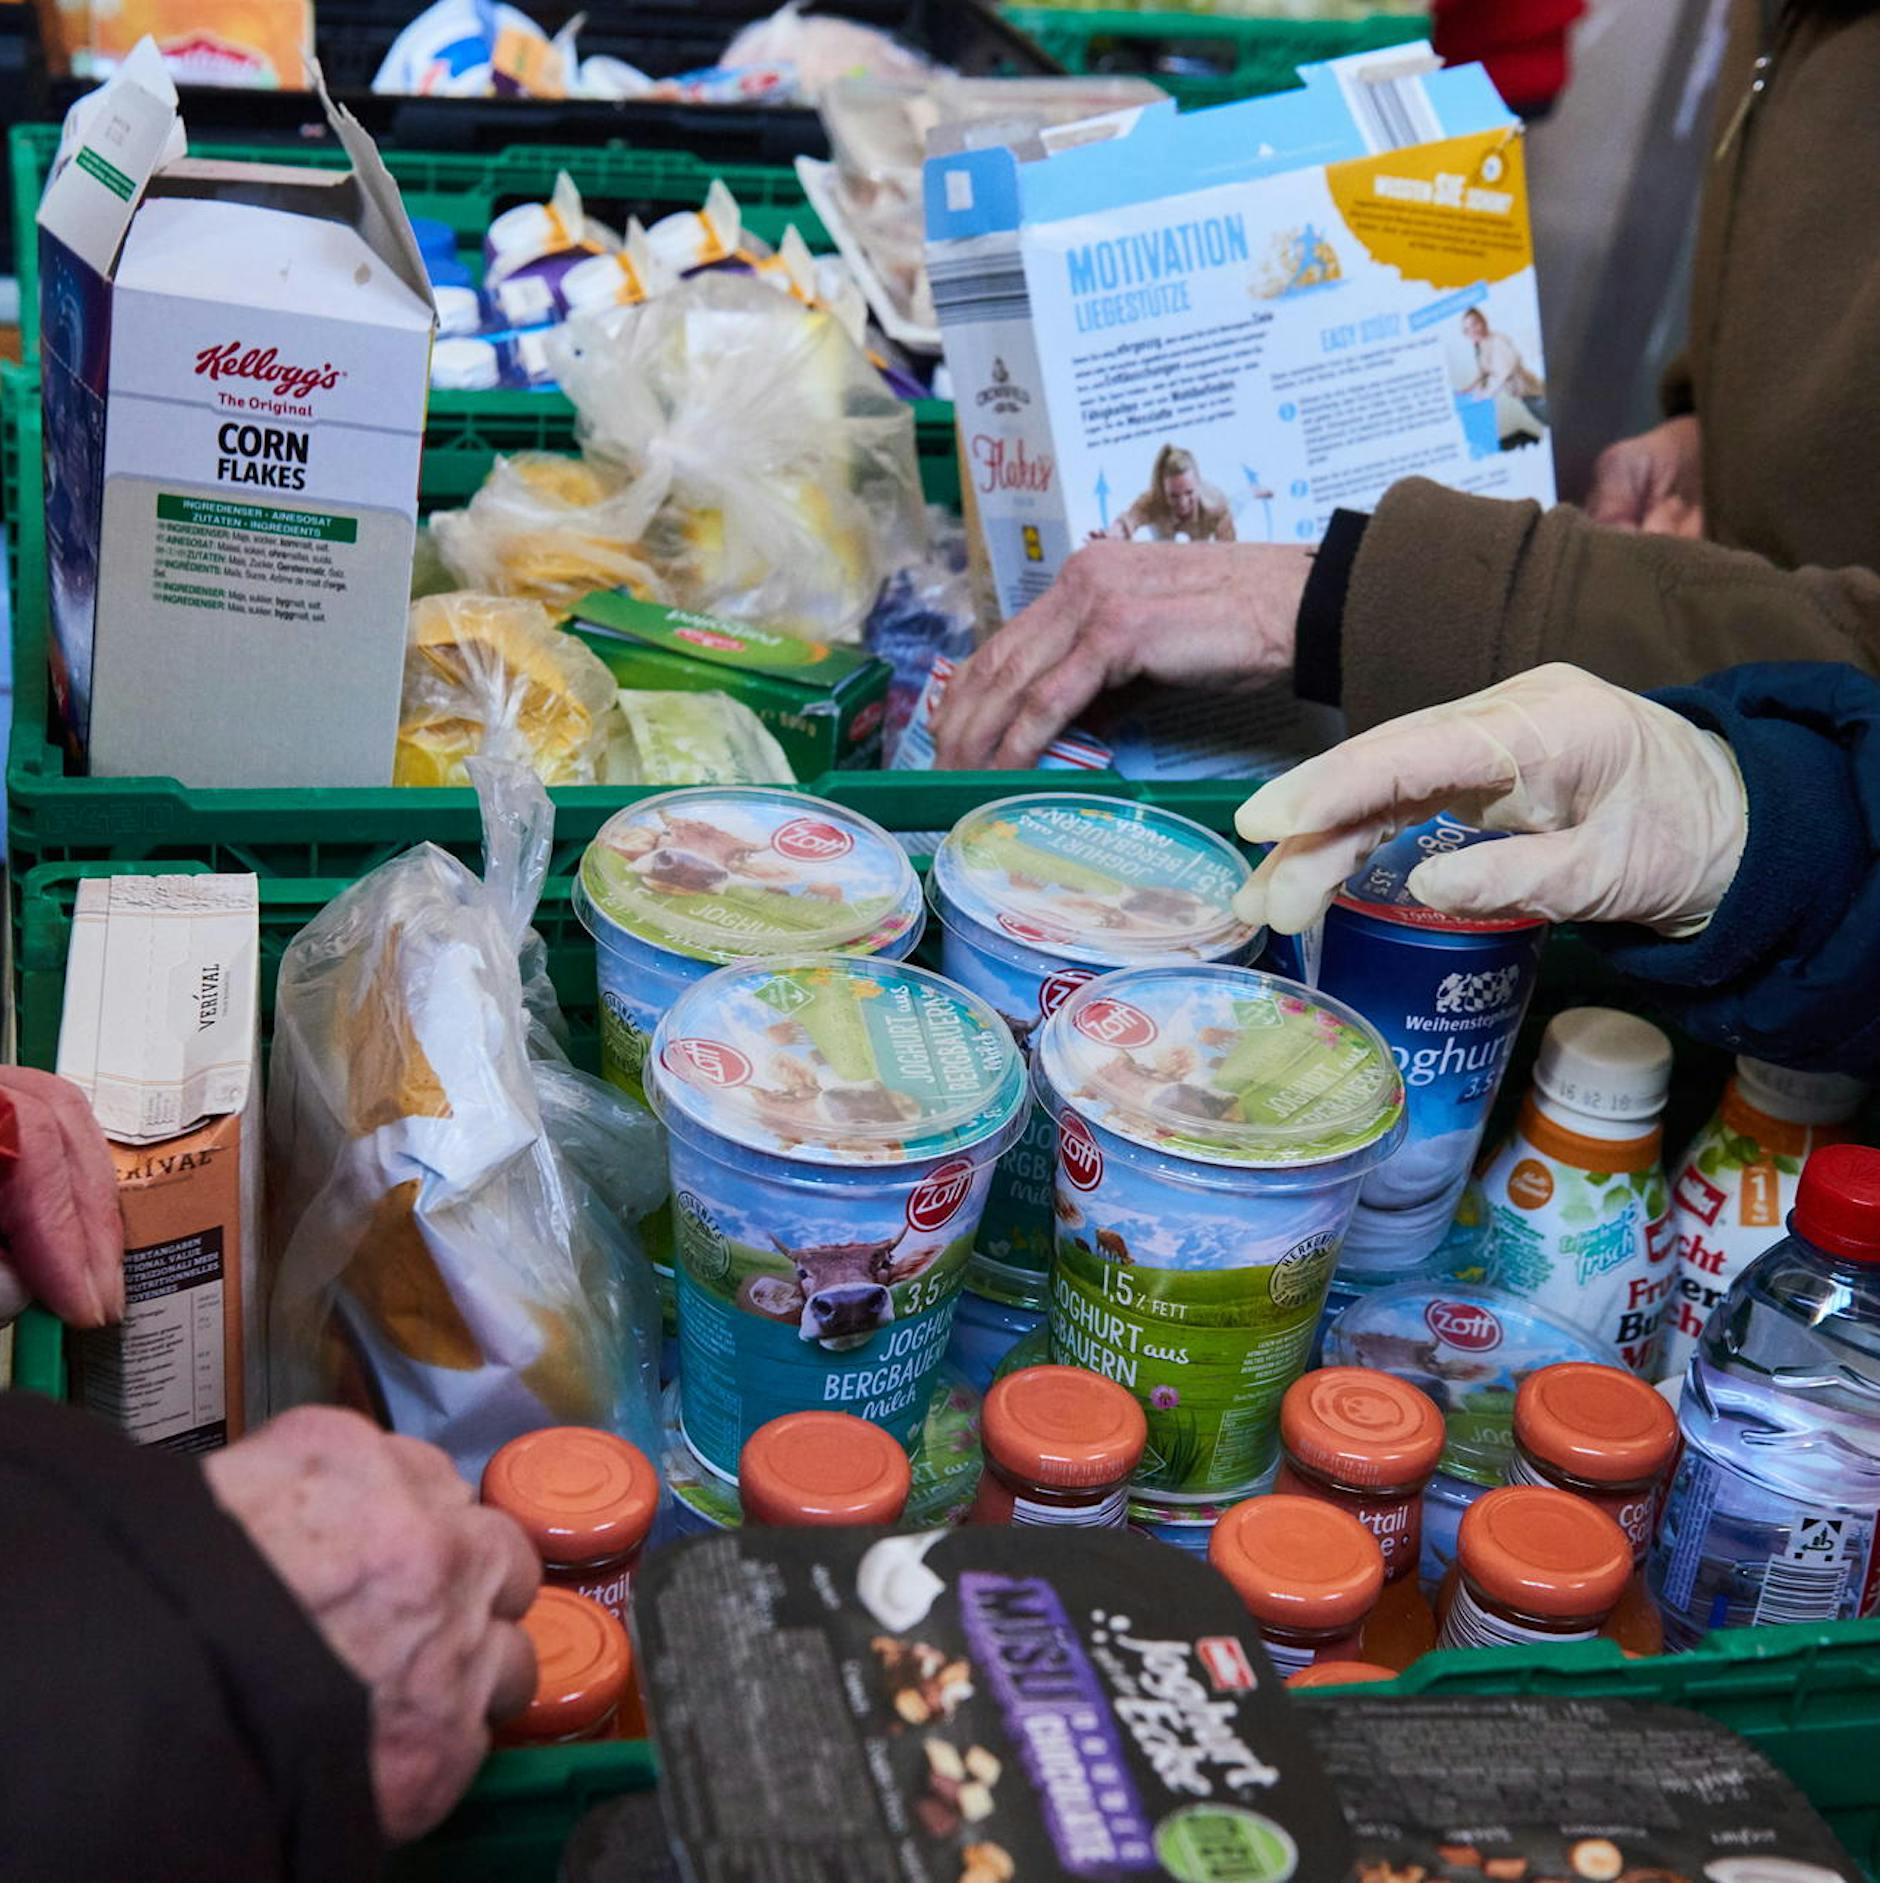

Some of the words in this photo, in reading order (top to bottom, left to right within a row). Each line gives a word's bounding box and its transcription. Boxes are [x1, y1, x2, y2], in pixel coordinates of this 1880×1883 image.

[1066, 212, 1248, 296] MOTIVATION
[195, 340, 340, 398] Kellogg's
[218, 392, 245, 408] The
[249, 397, 313, 417] Original
[217, 422, 309, 465] CORN
[217, 458, 306, 491] FLAKES
[183, 500, 263, 518] INGREDIENSER
[272, 511, 332, 528] AINESOSAT
[192, 514, 242, 528] ZUTATEN
[1049, 831, 1155, 878] JOGHURT
[889, 984, 911, 1013] aus
[1084, 1006, 1143, 1041] Zott
[885, 1014, 937, 1085] JOGHURT
[1062, 1130, 1102, 1175] Zott
[915, 1172, 973, 1216] Zott
[1054, 1270, 1145, 1355] JOGHURT
[1143, 1342, 1190, 1366] aus
[1151, 1300, 1188, 1321] FETT
[1434, 1307, 1496, 1340] Zott
[862, 1384, 917, 1421] Milch
